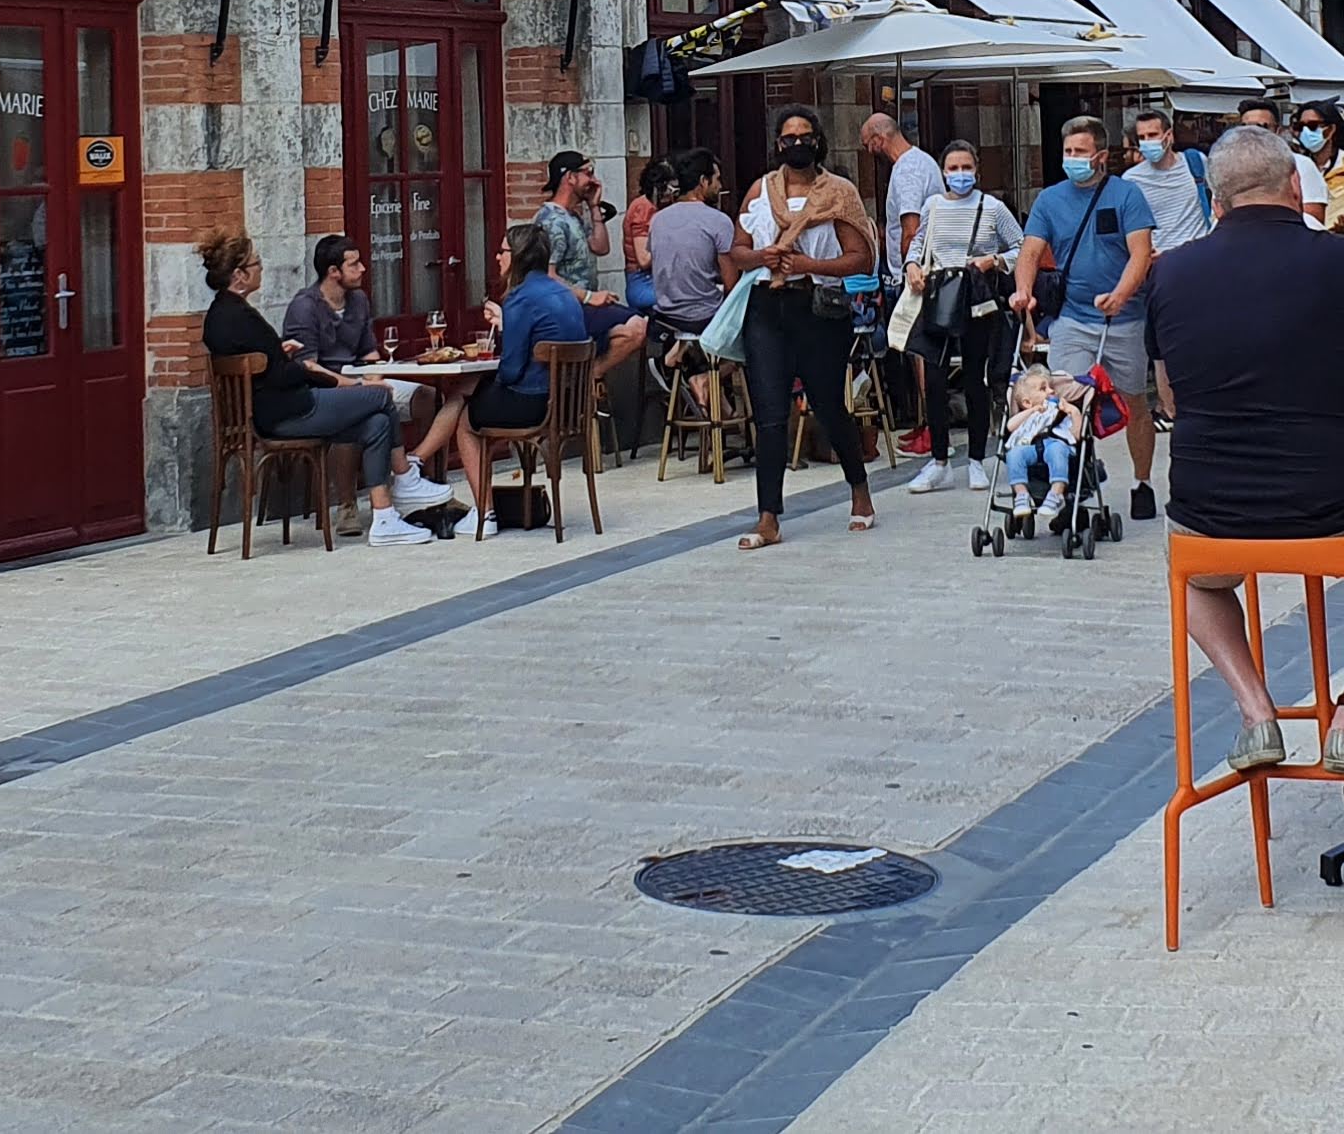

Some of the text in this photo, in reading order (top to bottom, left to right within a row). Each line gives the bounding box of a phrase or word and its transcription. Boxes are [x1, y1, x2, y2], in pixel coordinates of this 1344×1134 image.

[368, 89, 438, 112] CHEZ MARIE
[413, 192, 430, 210] Fine
